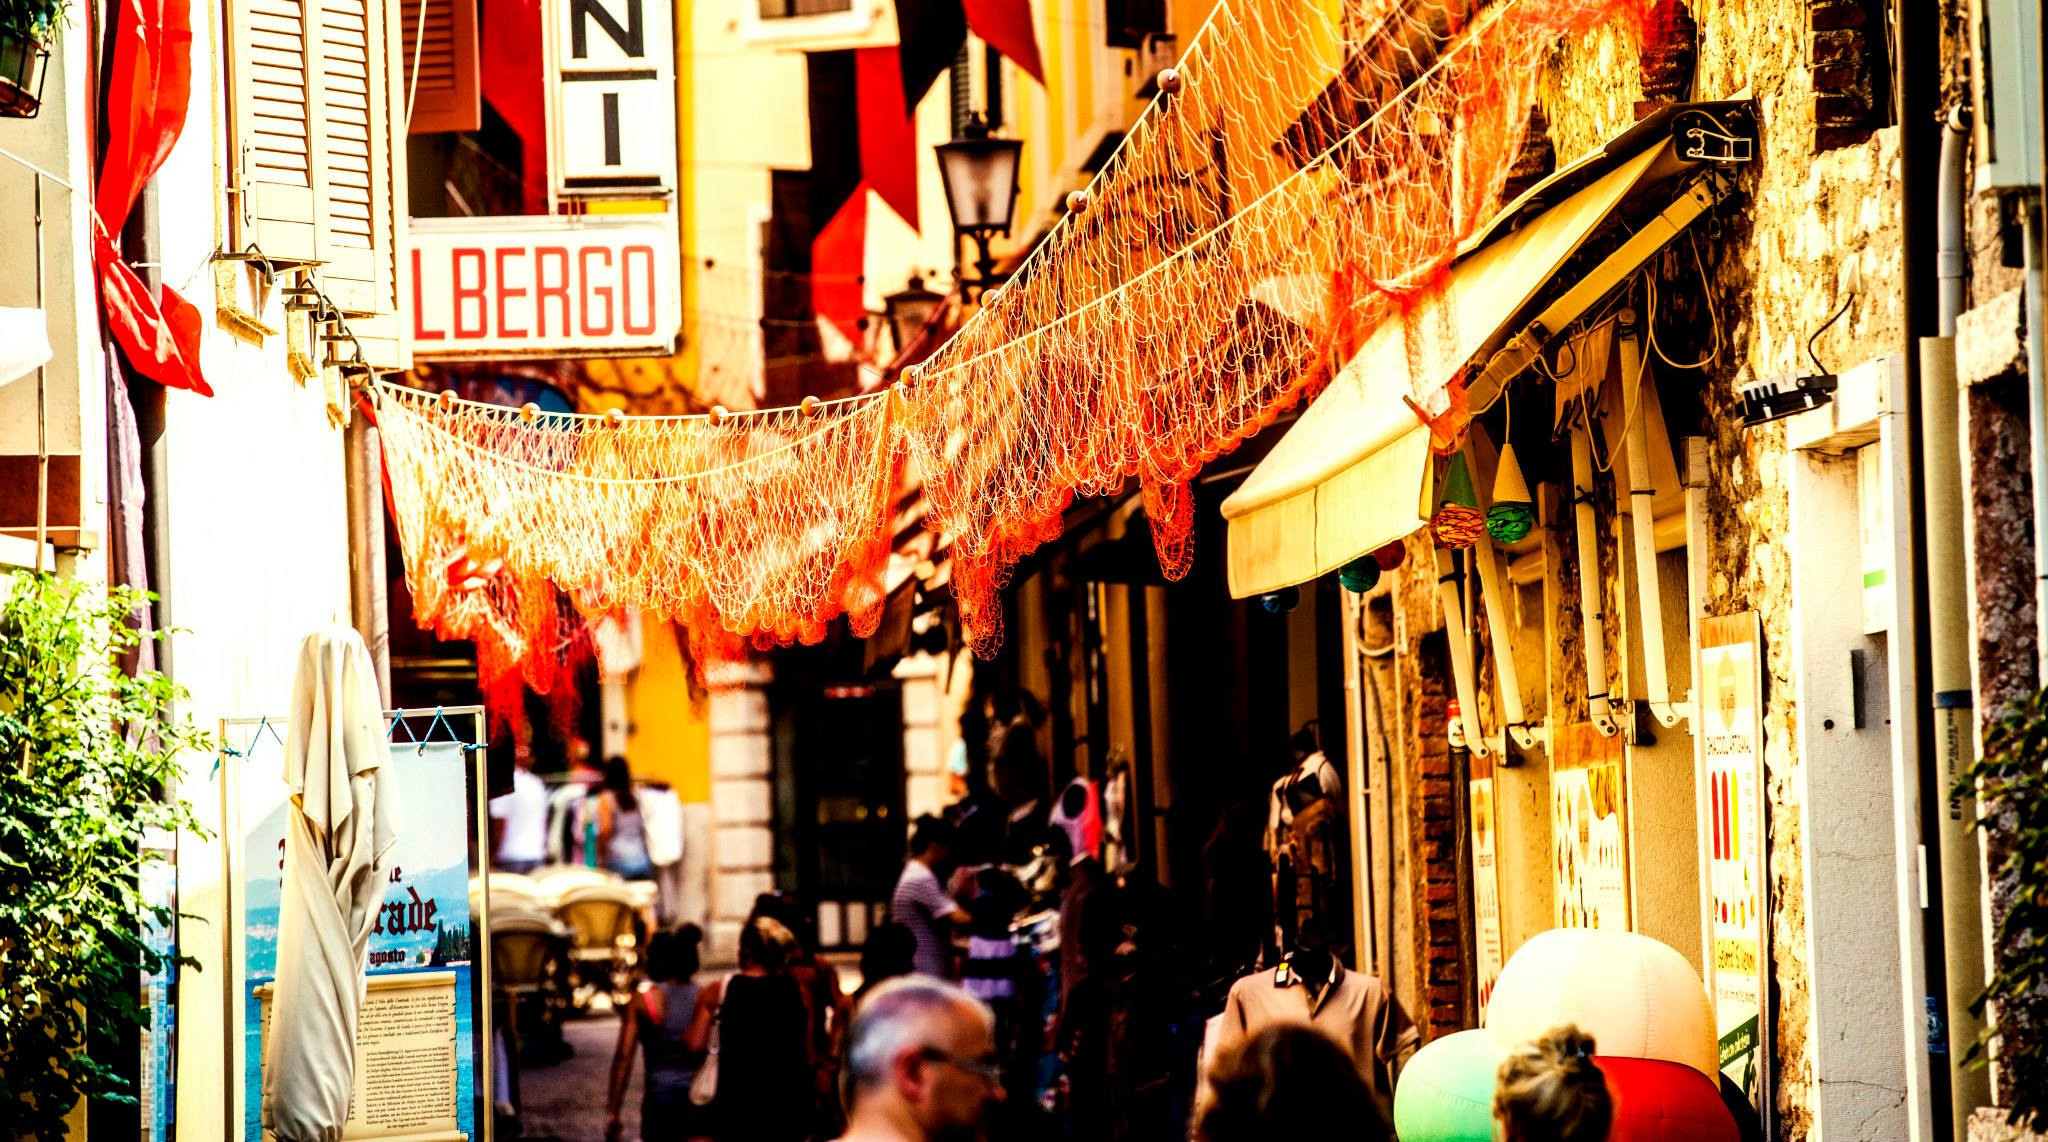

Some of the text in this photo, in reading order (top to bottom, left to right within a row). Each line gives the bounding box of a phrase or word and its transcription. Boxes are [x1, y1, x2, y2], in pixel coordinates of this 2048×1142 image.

[411, 246, 657, 341] LBERGO
[371, 886, 438, 936] rade
[369, 948, 405, 967] agosto
